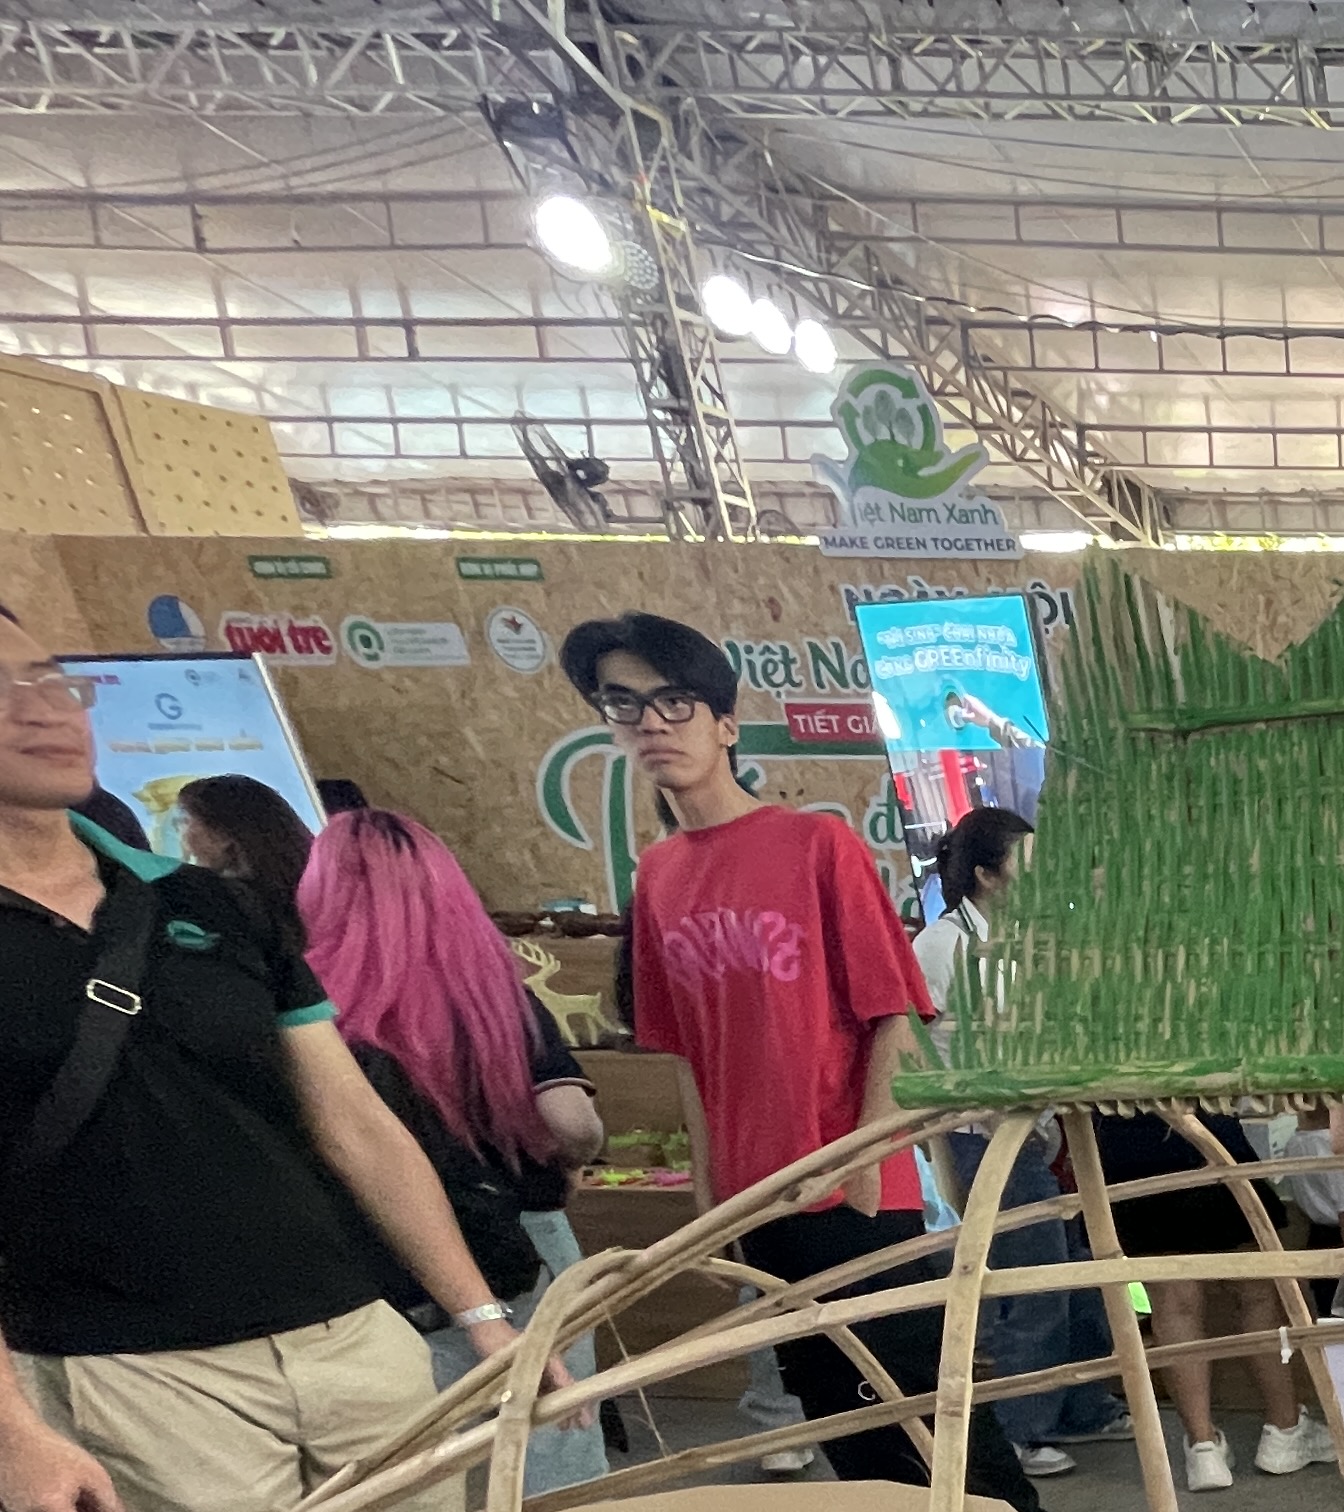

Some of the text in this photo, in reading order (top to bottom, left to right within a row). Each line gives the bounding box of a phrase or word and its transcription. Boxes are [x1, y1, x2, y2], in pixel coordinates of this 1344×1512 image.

[888, 502, 940, 524] Nam
[943, 502, 1000, 525] Xanh
[824, 535, 1016, 552] MAKE GREEN TOGETHER
[794, 709, 840, 733] TIẾT
